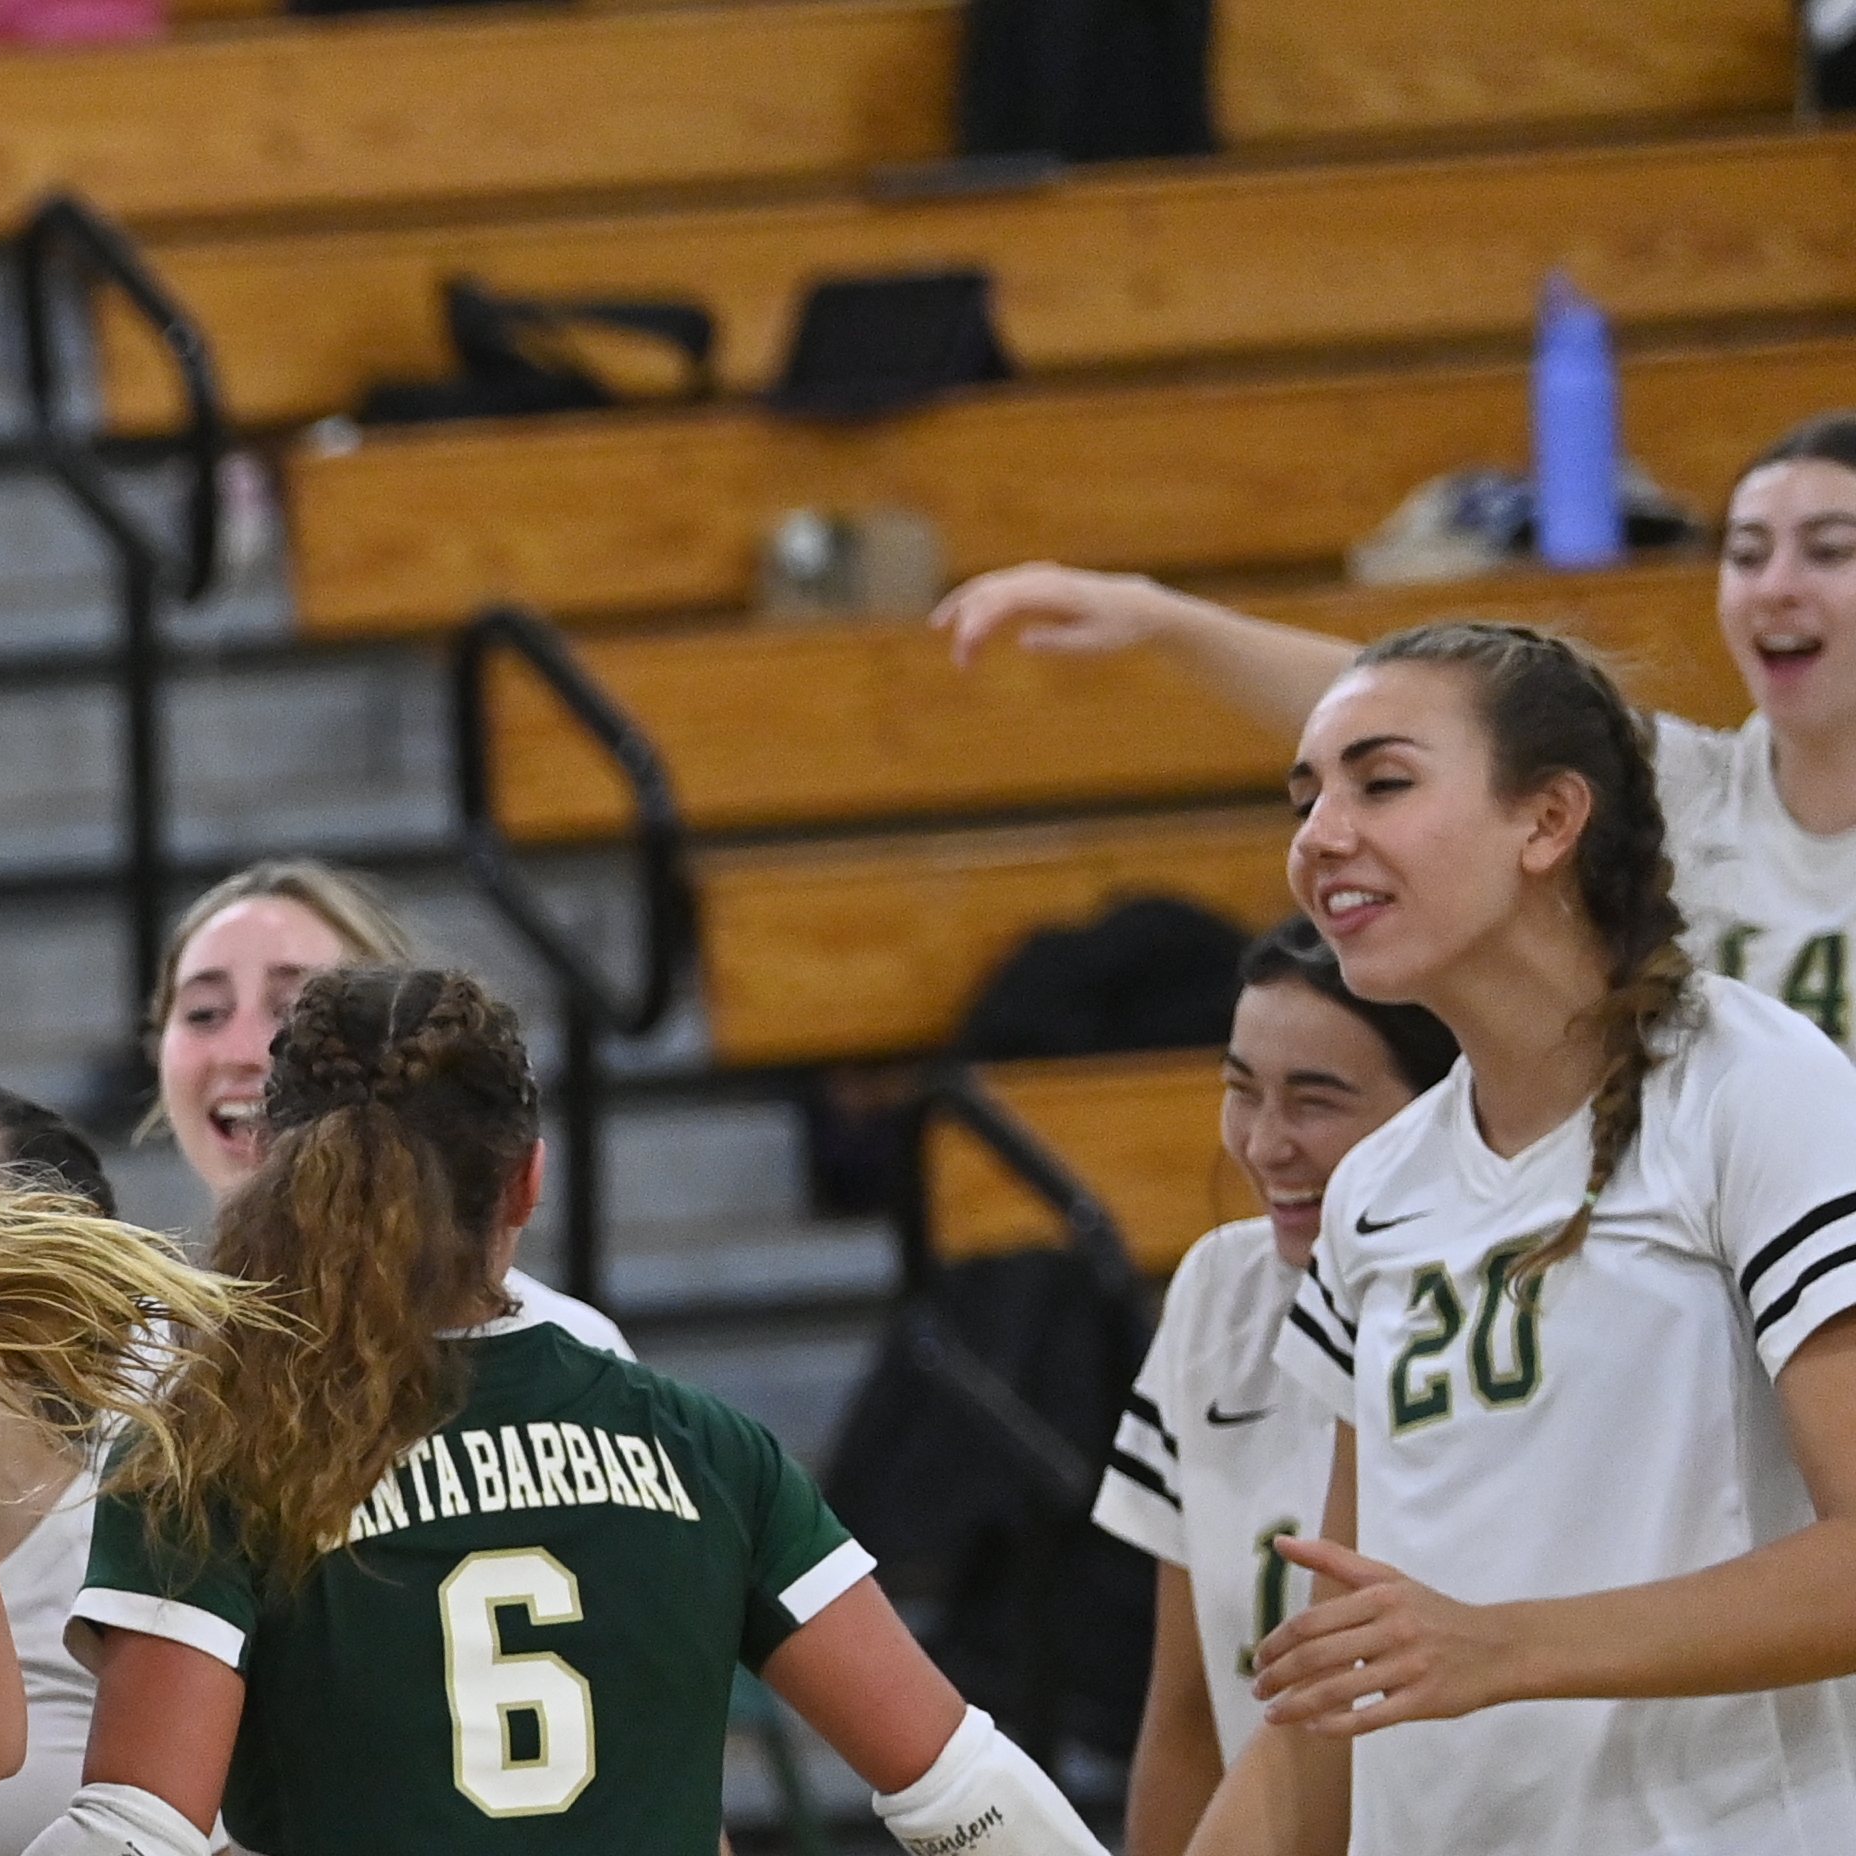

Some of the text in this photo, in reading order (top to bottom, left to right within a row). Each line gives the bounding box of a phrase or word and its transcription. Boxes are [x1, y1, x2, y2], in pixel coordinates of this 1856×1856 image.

[1390, 1234, 1544, 1437] 20
[461, 1421, 701, 1522] BARBARA
[438, 1546, 596, 1819] 6
